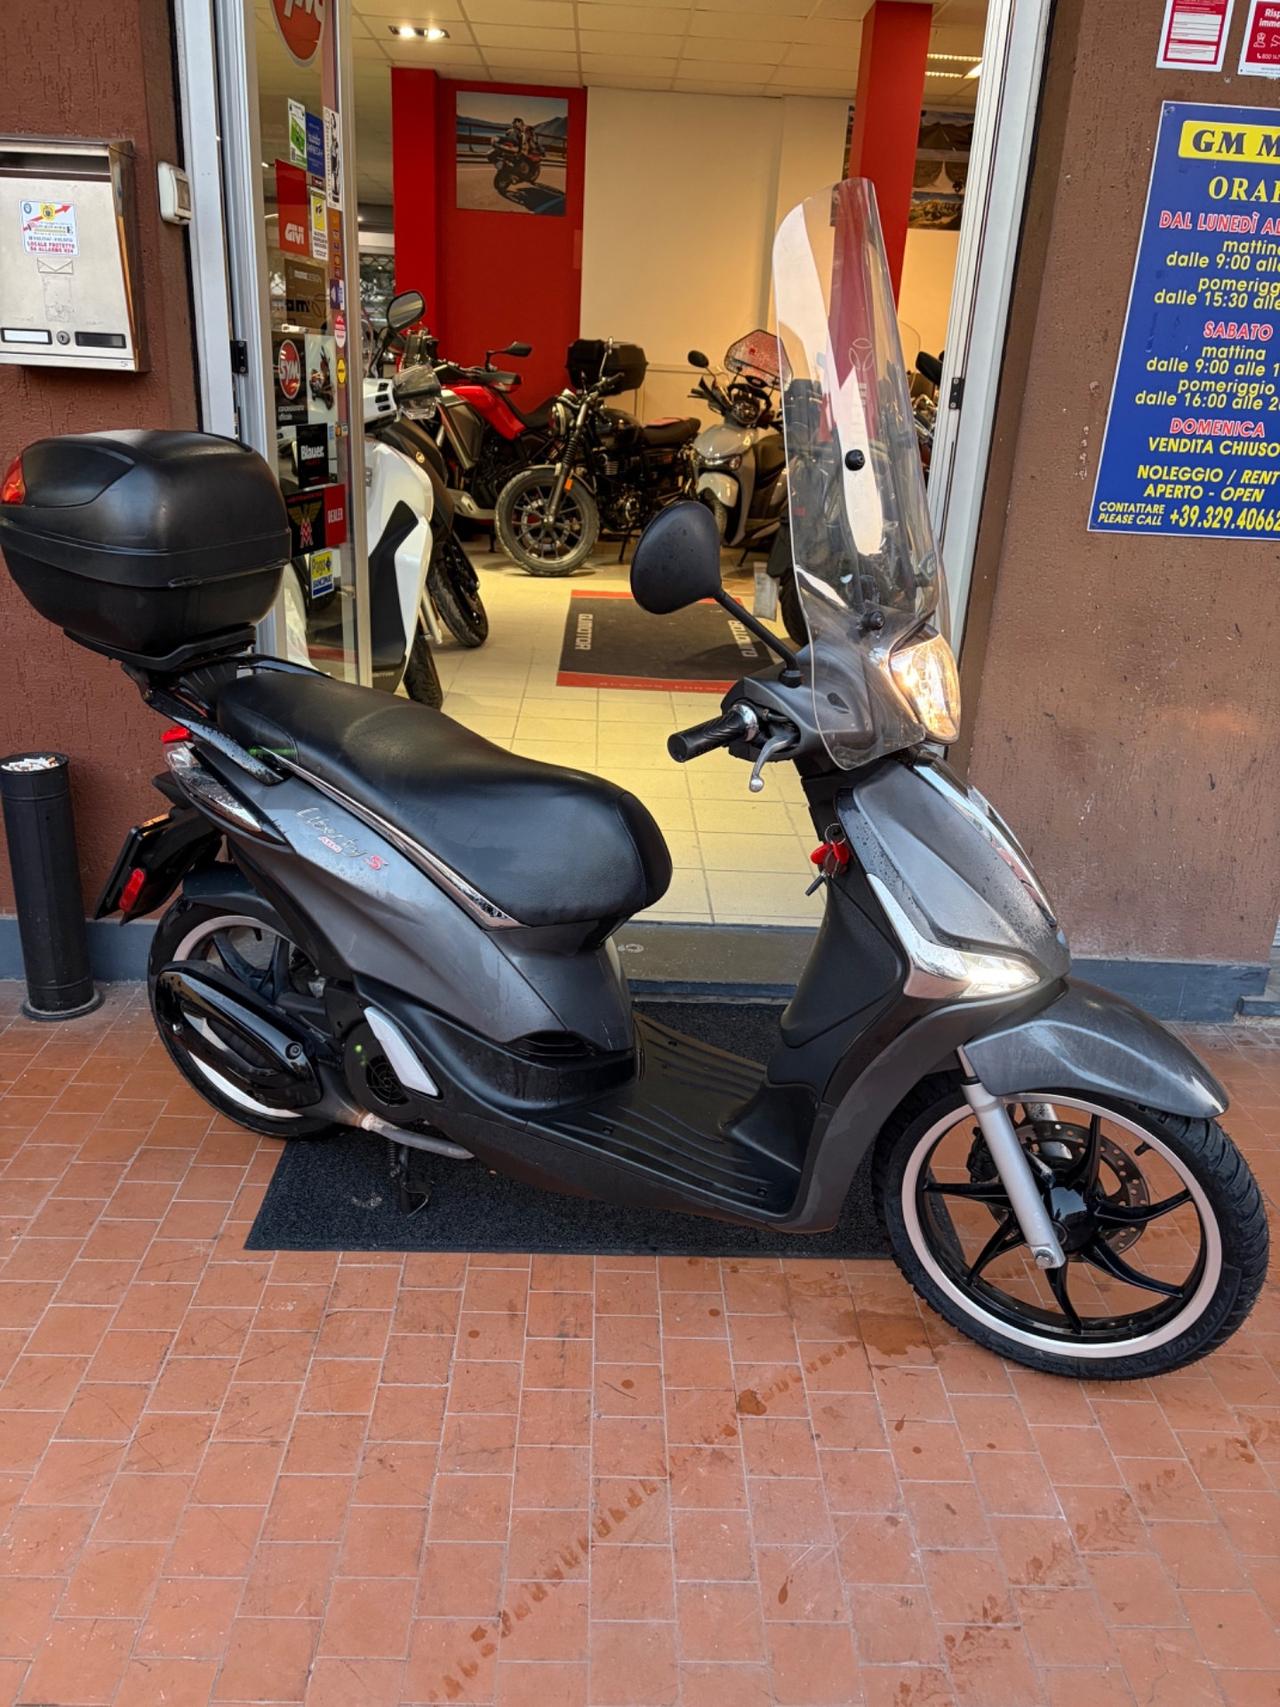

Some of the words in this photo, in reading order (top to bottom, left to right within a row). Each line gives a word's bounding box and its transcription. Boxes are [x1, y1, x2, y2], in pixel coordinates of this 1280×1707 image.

[1192, 129, 1246, 155] GM
[1159, 210, 1192, 229] DAL
[1197, 211, 1260, 234] LUNEDÌ
[1166, 251, 1209, 268] dalle
[1216, 253, 1251, 271] 9:00
[1154, 288, 1197, 306] dalle
[1204, 291, 1248, 308] 15:30
[1203, 320, 1273, 342] SABATO
[1201, 344, 1266, 361] mattina
[1146, 356, 1189, 373] dalle
[1195, 358, 1229, 374] 9:00
[1234, 361, 1266, 377] alle
[1177, 378, 1275, 397] pomeriggio
[1135, 390, 1177, 406] dalle
[1184, 392, 1227, 408] 16:00
[1231, 395, 1263, 410] alle
[1169, 417, 1265, 438] DOMENICA
[1148, 436, 1214, 454] VENDITA
[1219, 440, 1280, 458] CHIUSO
[1136, 464, 1223, 482] NOLEGGIO
[1226, 468, 1237, 485] /
[1240, 469, 1280, 486] RENT
[1143, 483, 1203, 499] APERTO
[1220, 487, 1265, 503] OPEN
[1098, 501, 1166, 514] CONTATTARE
[1097, 513, 1135, 525] PLEASE
[1136, 514, 1163, 526] CALL
